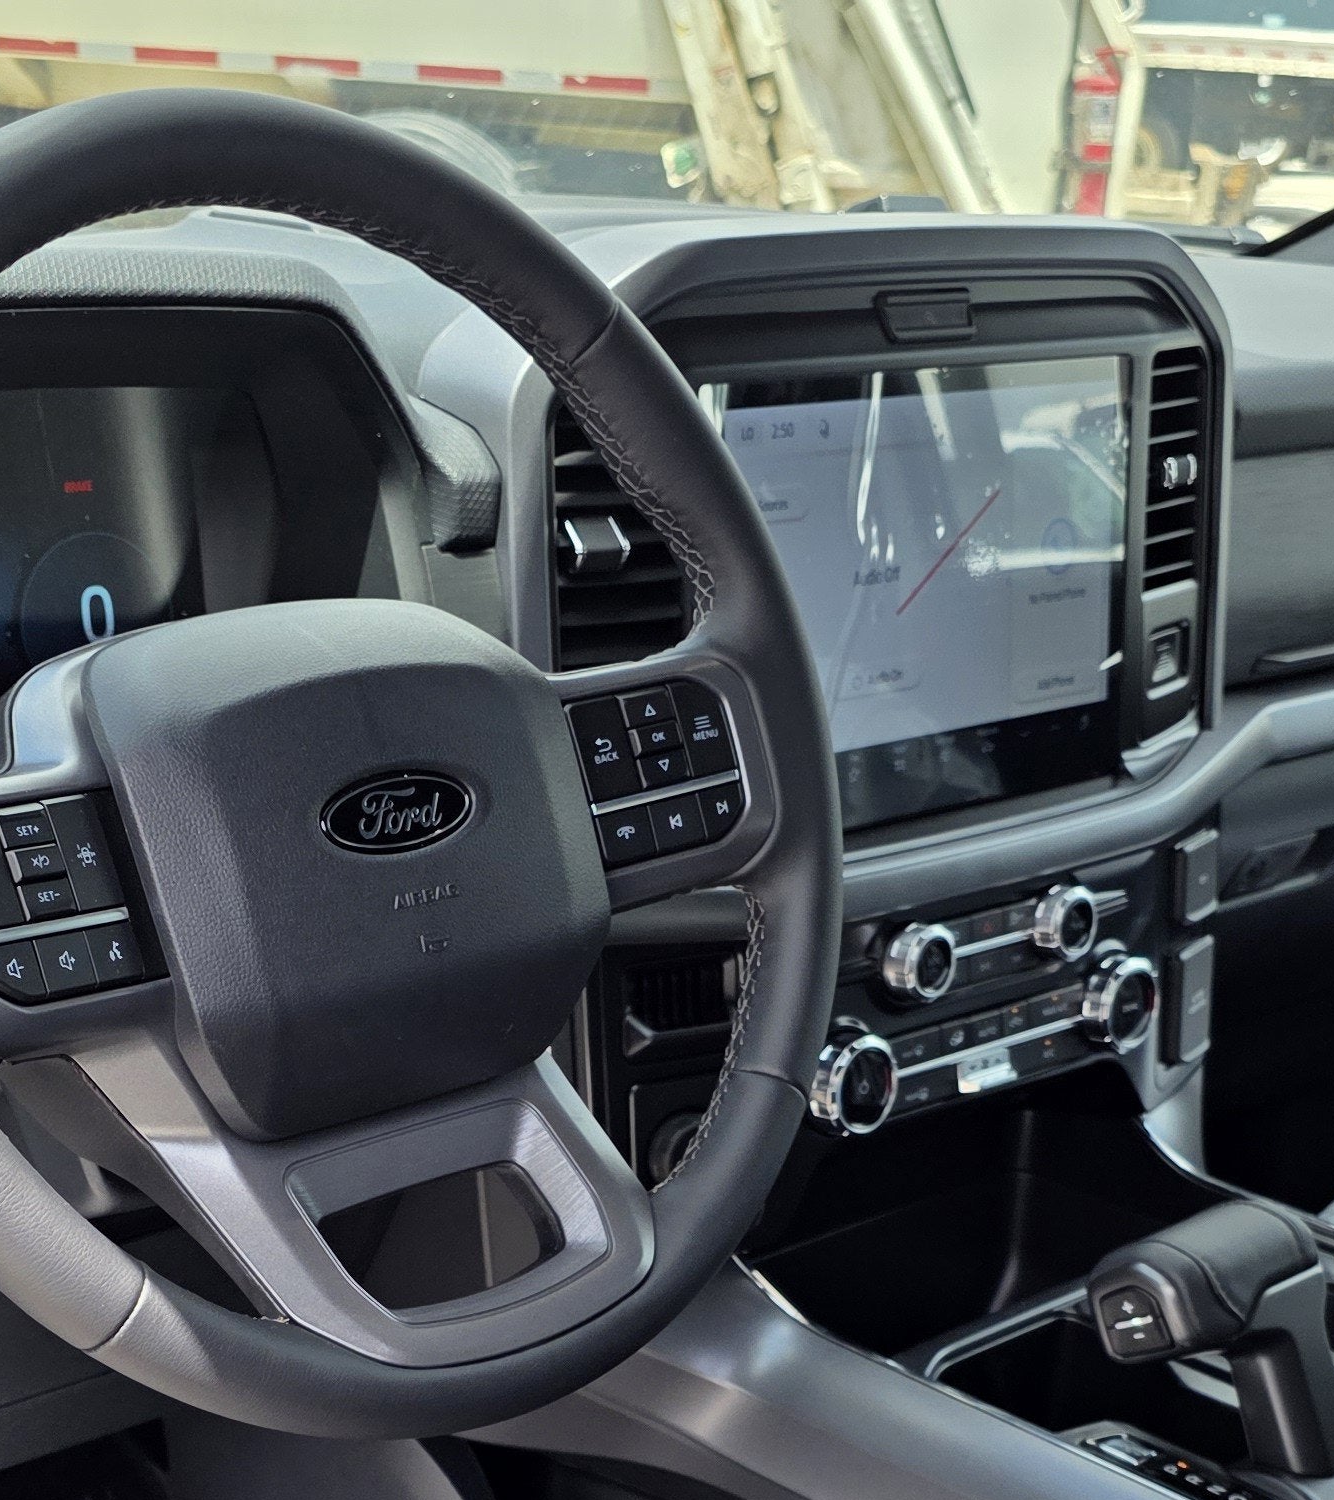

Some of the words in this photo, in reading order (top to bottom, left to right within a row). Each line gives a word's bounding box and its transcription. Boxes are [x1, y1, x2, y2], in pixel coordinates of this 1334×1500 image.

[80, 584, 115, 643] 0
[651, 731, 666, 742] OK
[692, 729, 719, 742] MENU
[594, 752, 619, 765] BACK
[358, 786, 443, 840] Ford
